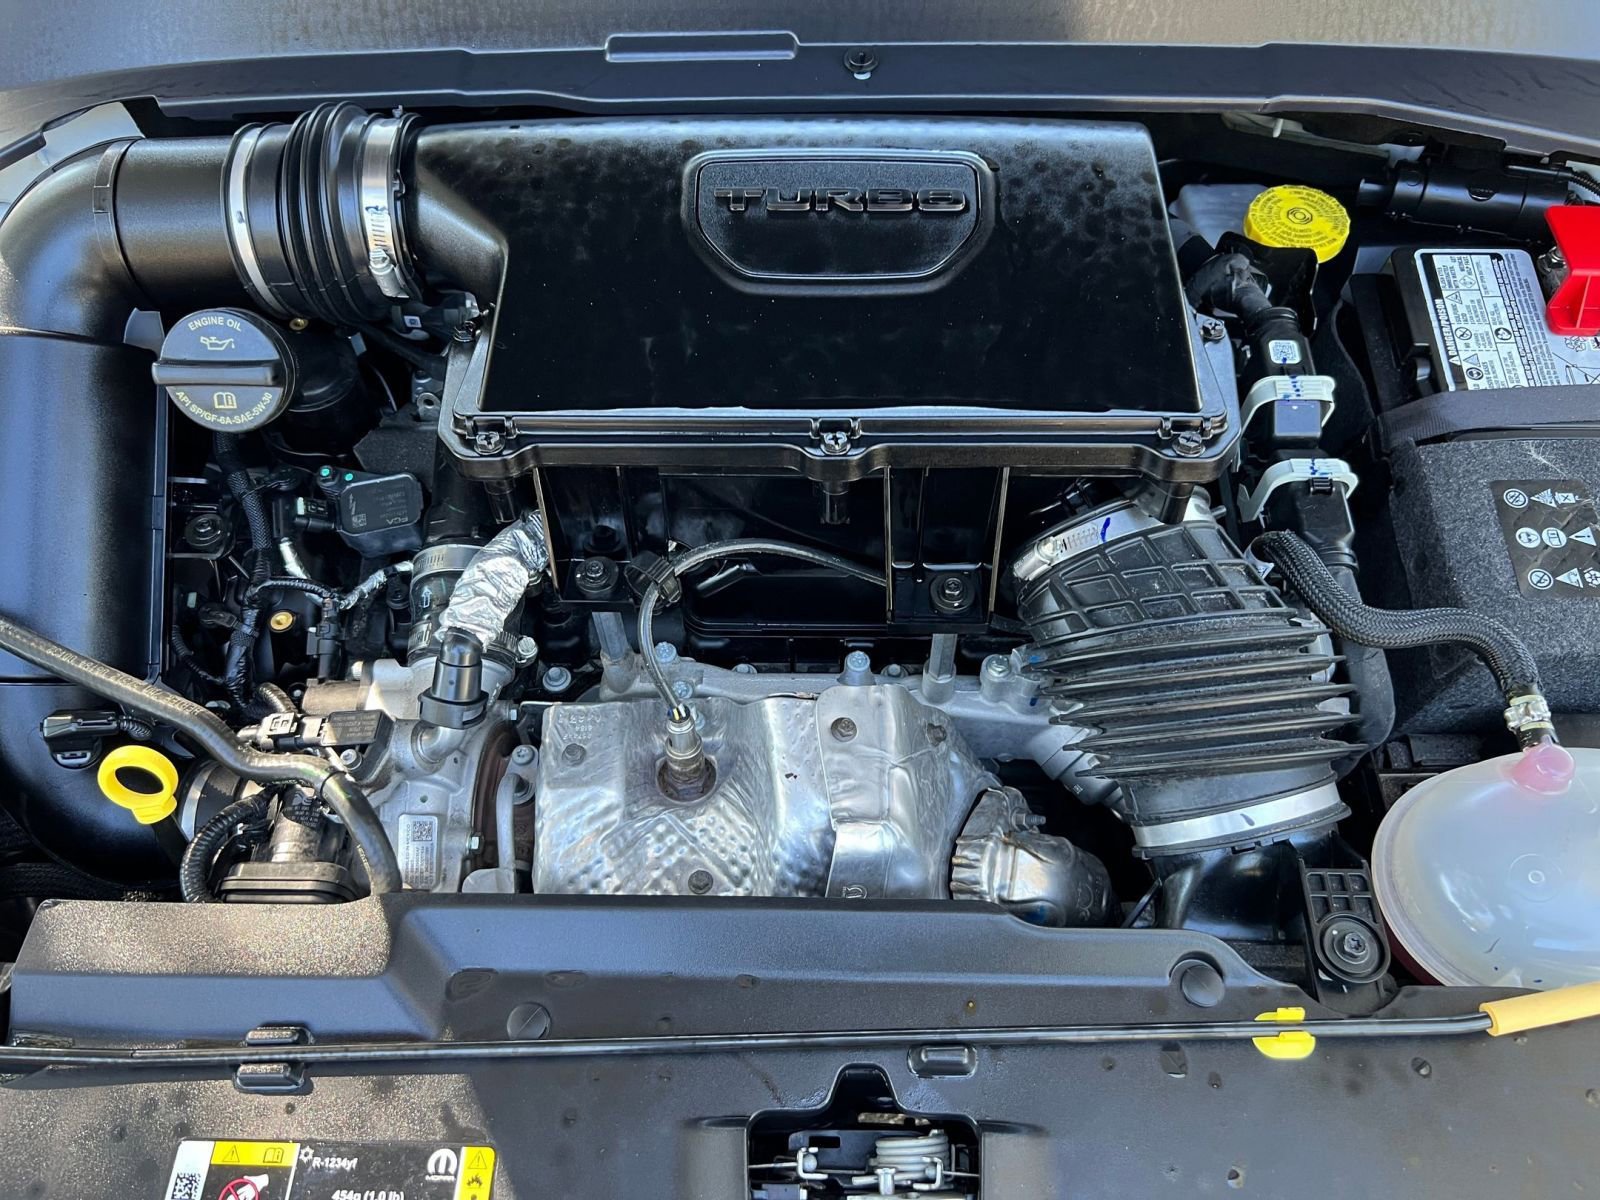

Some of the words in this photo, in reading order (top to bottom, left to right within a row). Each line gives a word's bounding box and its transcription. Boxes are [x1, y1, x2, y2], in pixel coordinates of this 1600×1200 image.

[714, 187, 967, 212] TURBO
[188, 316, 224, 331] ENGINE
[226, 319, 242, 332] OIL
[1435, 299, 1458, 355] DANGER/POISON
[176, 392, 191, 406] API
[386, 516, 408, 525] FCA
[312, 1157, 358, 1172] R-1234yf
